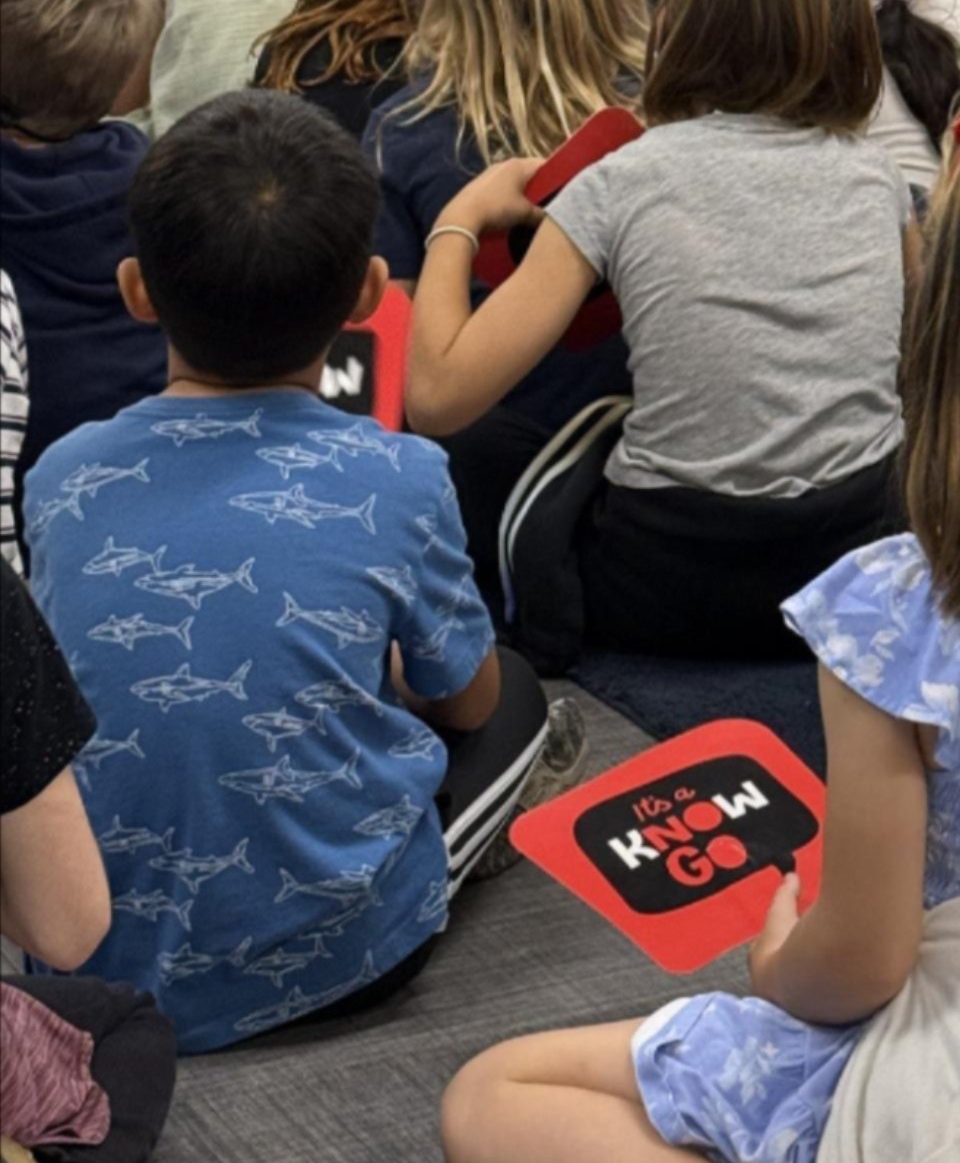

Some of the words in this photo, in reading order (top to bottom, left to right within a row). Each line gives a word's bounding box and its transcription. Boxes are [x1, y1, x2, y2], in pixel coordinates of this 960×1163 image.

[606, 779, 771, 871] KNOW
[632, 795, 674, 822] It's
[673, 787, 697, 803] a
[665, 834, 749, 887] GO
